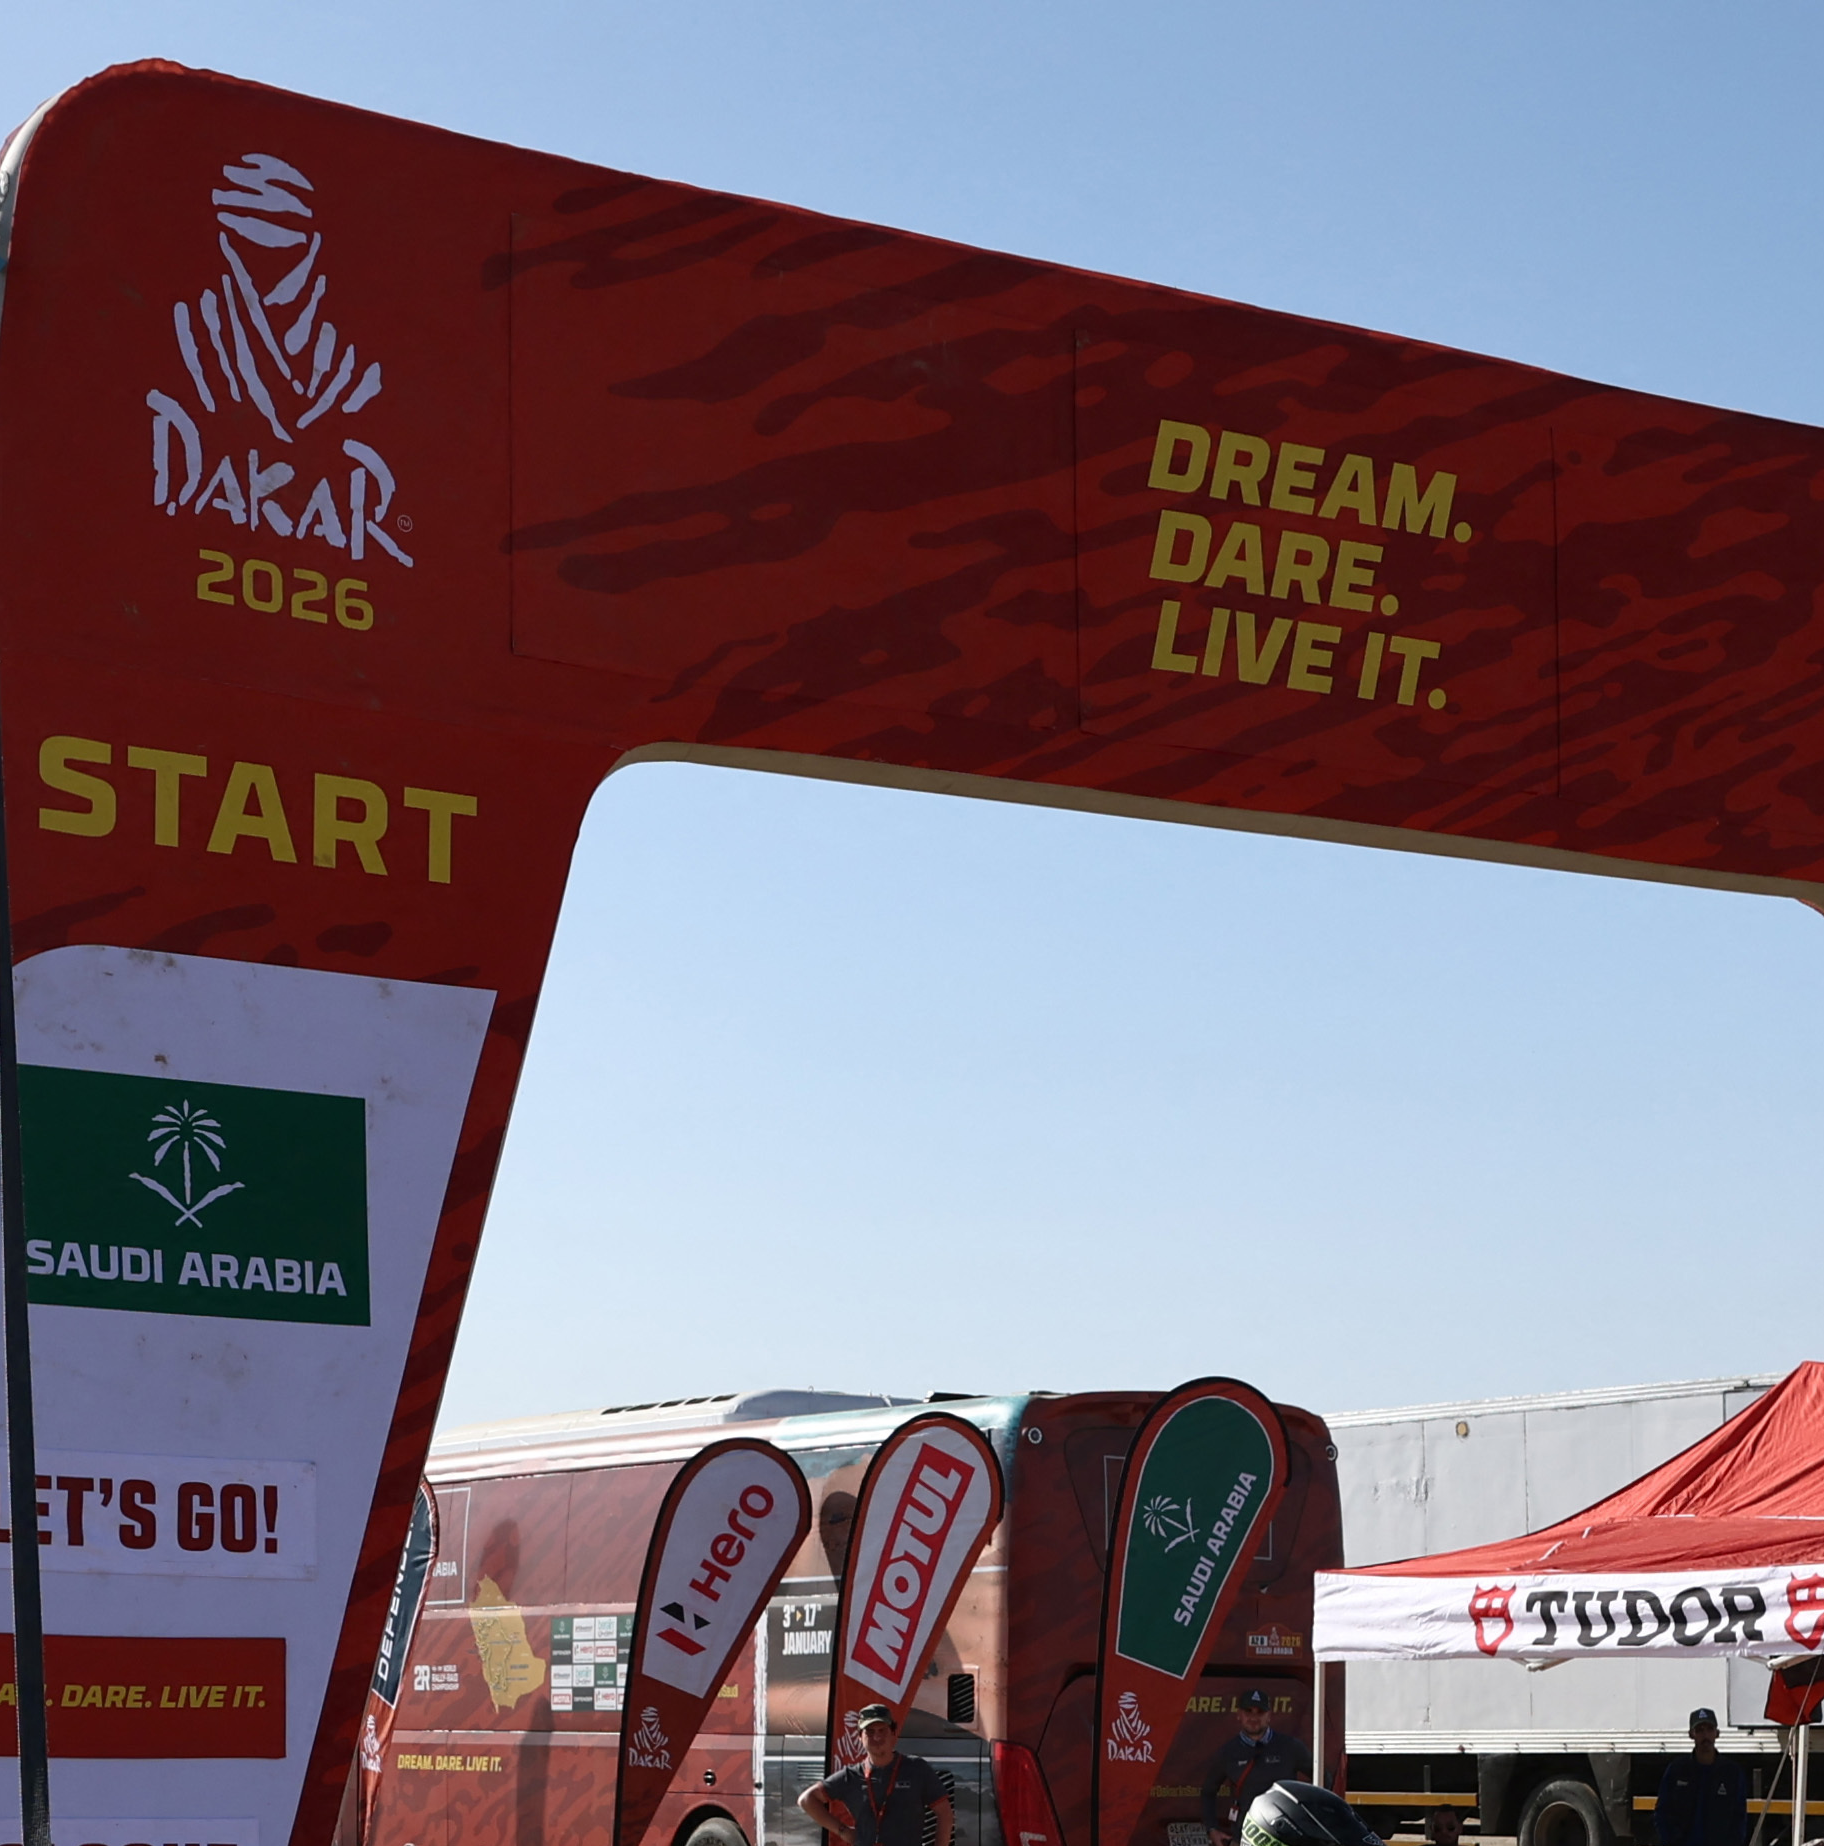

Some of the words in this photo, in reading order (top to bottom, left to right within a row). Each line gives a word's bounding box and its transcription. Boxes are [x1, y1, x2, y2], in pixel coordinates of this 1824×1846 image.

[146, 389, 413, 568] DAKAR
[1147, 418, 1472, 543] DREAM.
[197, 548, 375, 632] 2026
[1148, 508, 1399, 617] DARE.
[1150, 599, 1343, 695] LIVE
[1357, 631, 1447, 710] IT.
[38, 734, 479, 885] START
[26, 1239, 164, 1285] SAUDI
[178, 1249, 348, 1298] ARABIA
[177, 1482, 280, 1554] GO!
[688, 1483, 775, 1603] Hero
[1173, 1555, 1216, 1627] SAUDI
[1207, 1471, 1258, 1557] ARABIA
[376, 1521, 415, 1683] DEFEN
[431, 1560, 458, 1577] ABIA
[864, 1461, 964, 1671] MOTUL
[782, 1630, 833, 1656] JANUARY
[1525, 1585, 1769, 1647] TUDOR
[61, 1683, 153, 1709] DARE.
[160, 1683, 226, 1708] LIVE
[233, 1683, 266, 1707] IT.
[1185, 1696, 1226, 1713] ARE.
[397, 1754, 434, 1771] DREAM.
[435, 1755, 465, 1771] DARE.
[466, 1755, 491, 1771] LIVE
[492, 1756, 503, 1772] IT.
[627, 1747, 673, 1772] DAKAR
[1106, 1736, 1157, 1764] DAKAR
